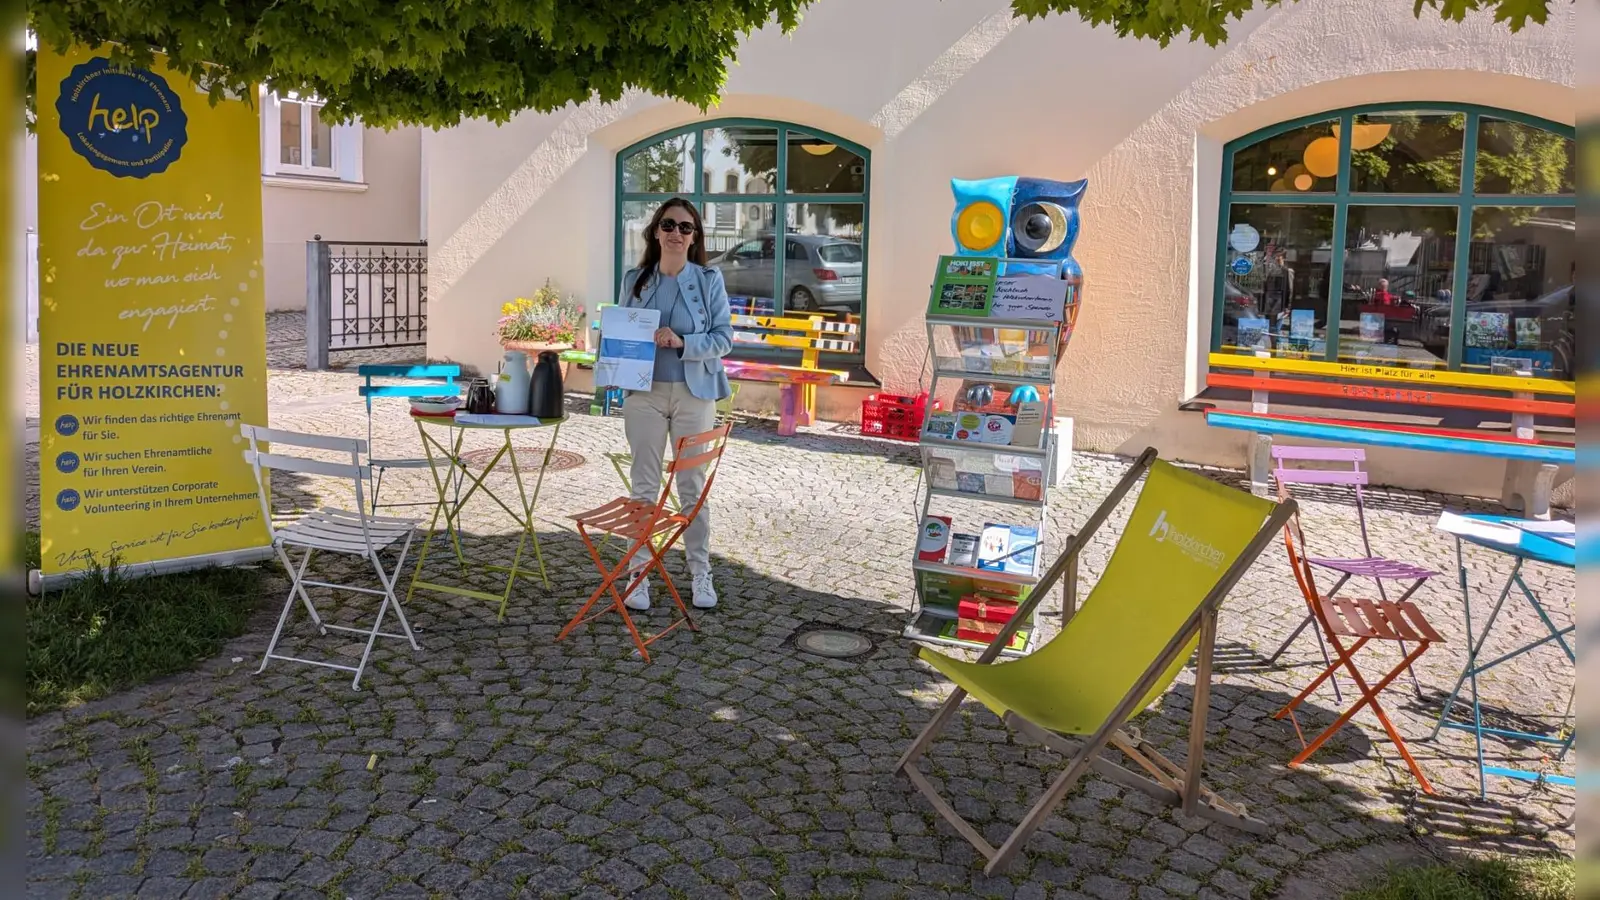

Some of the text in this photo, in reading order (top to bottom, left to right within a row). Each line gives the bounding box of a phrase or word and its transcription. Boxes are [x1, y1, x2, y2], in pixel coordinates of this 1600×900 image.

[71, 71, 101, 102] Holzkirchner
[137, 74, 149, 83] für
[149, 81, 172, 112] Ehrenamt
[87, 92, 160, 144] help
[77, 132, 130, 166] Lokalengagement
[80, 201, 224, 230] Ein Ort wird
[77, 232, 235, 270] da zur Heimat,
[105, 264, 221, 288] wo man sich
[118, 295, 217, 332] engagiert.
[56, 342, 139, 357] DIE NEUE
[56, 364, 244, 378] EHRENAMTSAGENTUR
[1340, 365, 1435, 380] Hier ist Platz für alle
[57, 383, 221, 400] FÜR HOLZKIRCHEN:
[83, 411, 241, 426] Wir finden das richtige Ehrenamt
[83, 430, 120, 440] für Sie.
[84, 446, 212, 462] Wir suchen Ehrenamtliche
[84, 463, 166, 477] für Ihren Verein.
[84, 480, 218, 499] Wir unterstützen Corporate
[84, 491, 260, 514] Volunteering in Ihrem Unternehmen.
[102, 541, 147, 559] Service
[150, 532, 168, 543] ist
[166, 529, 185, 546] für
[184, 522, 207, 539] Sie
[209, 509, 259, 530] kostenfrei!
